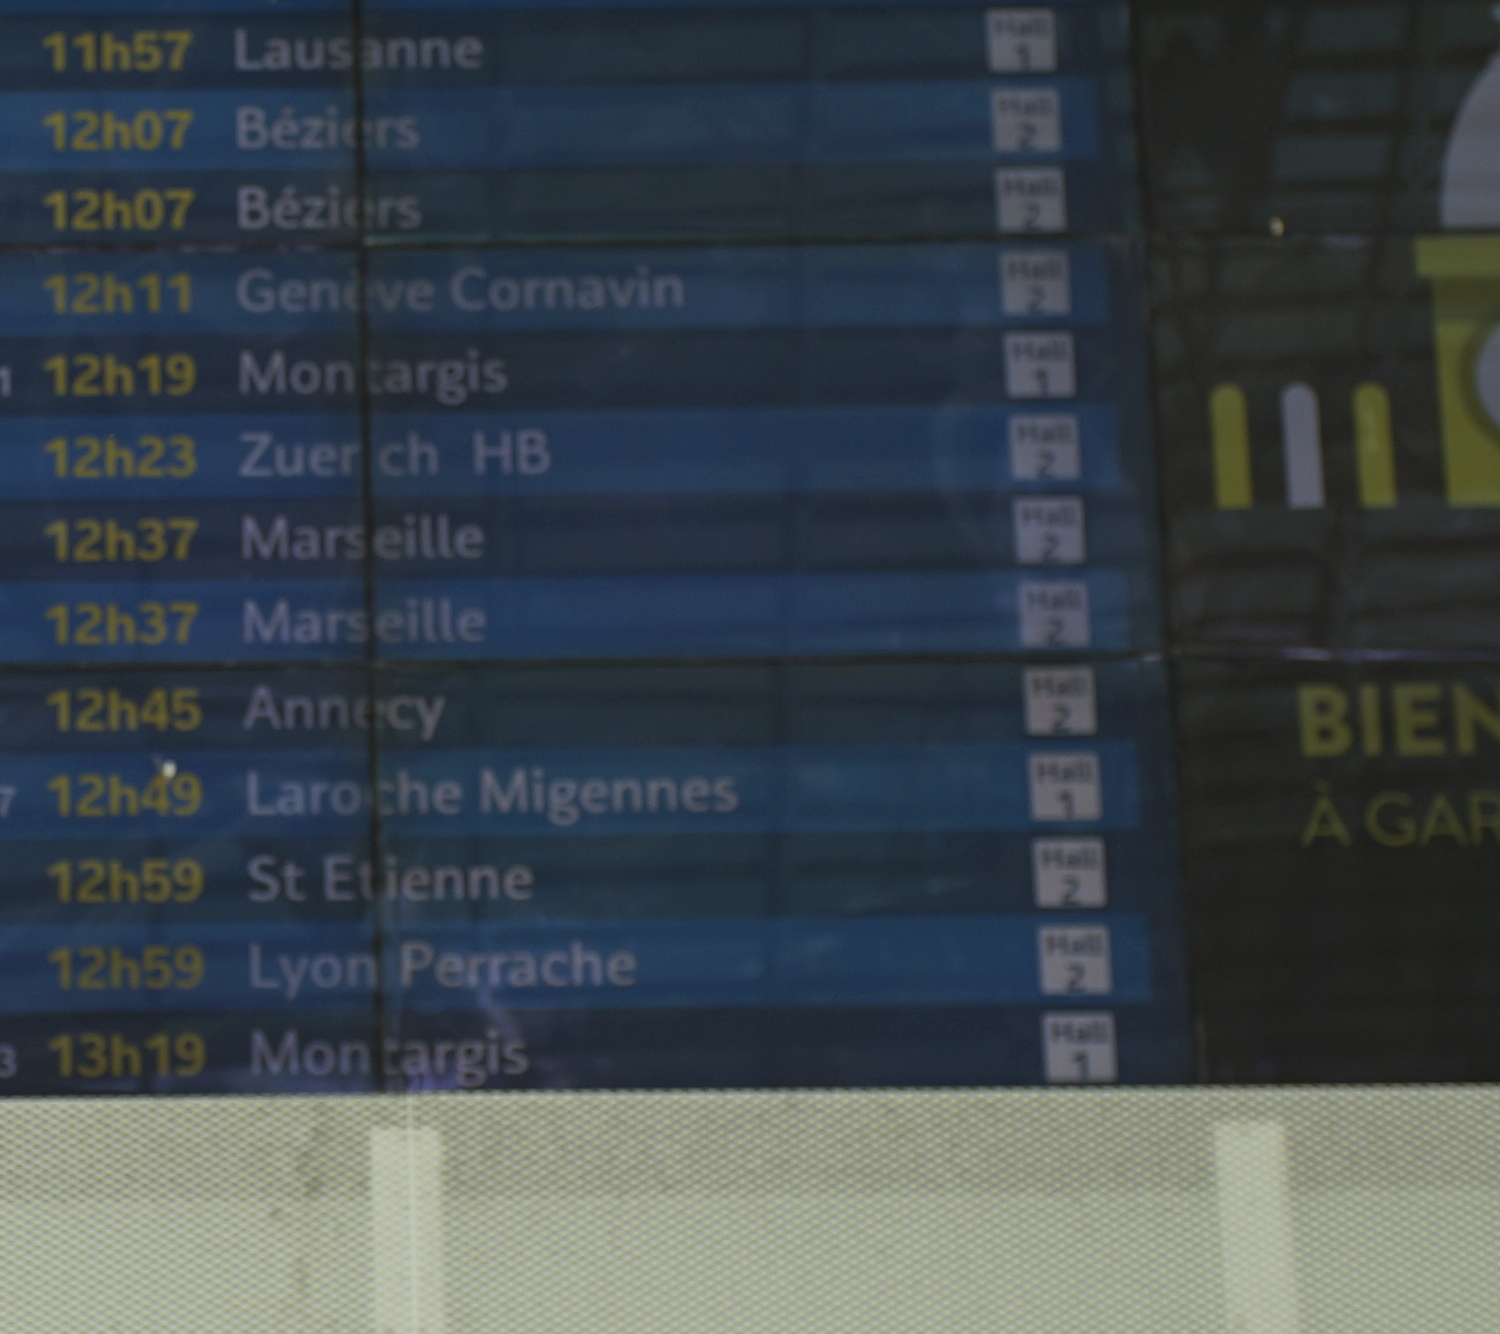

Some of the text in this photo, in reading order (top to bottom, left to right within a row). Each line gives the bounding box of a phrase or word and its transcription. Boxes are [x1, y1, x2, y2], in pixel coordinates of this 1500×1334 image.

[44, 31, 192, 71] 11h57
[234, 28, 482, 70] Lausanne
[44, 109, 192, 150] 12h07
[44, 189, 194, 229] 12h07
[44, 272, 192, 313] 12h11
[450, 264, 684, 311] Cornavin
[44, 354, 197, 396] 12h19
[44, 436, 198, 477] 12h23
[241, 429, 438, 475] Zuerch
[473, 429, 550, 475] HB
[45, 519, 198, 561] 12h37
[241, 512, 484, 559] Marseille
[45, 603, 198, 645] 12h37
[242, 598, 486, 643] Marseille
[46, 688, 201, 731] 12h45
[46, 774, 202, 816] 12h49
[480, 767, 738, 824] Migennes
[1301, 782, 1352, 848] À
[49, 861, 203, 902] 12h59
[248, 854, 308, 902] St
[49, 946, 204, 988] 12h59
[250, 942, 377, 999] Lyon
[402, 940, 636, 988] Perrache
[50, 1032, 206, 1075] 13h19
